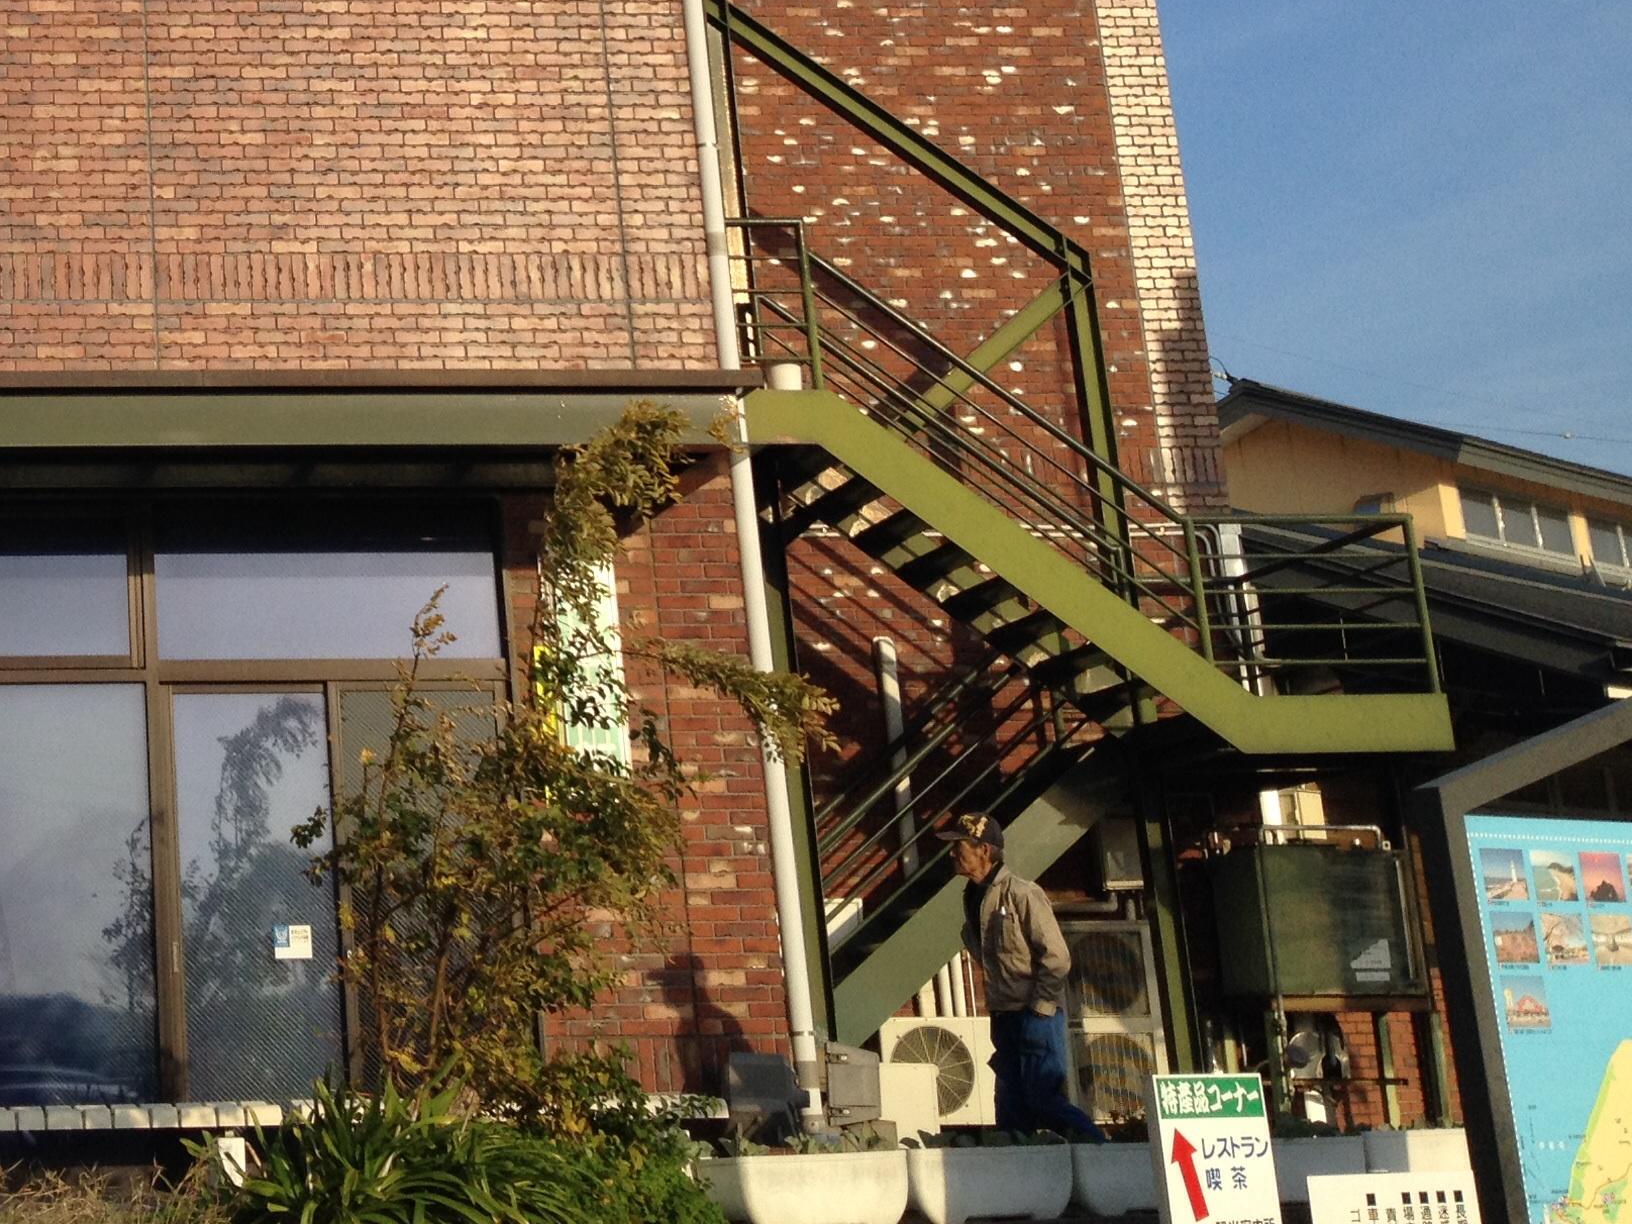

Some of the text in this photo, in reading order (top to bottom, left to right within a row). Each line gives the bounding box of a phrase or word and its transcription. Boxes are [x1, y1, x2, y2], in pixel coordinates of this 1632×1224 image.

[1160, 1080, 1259, 1115] 特産品コーナー
[1201, 1136, 1269, 1160] レストラン
